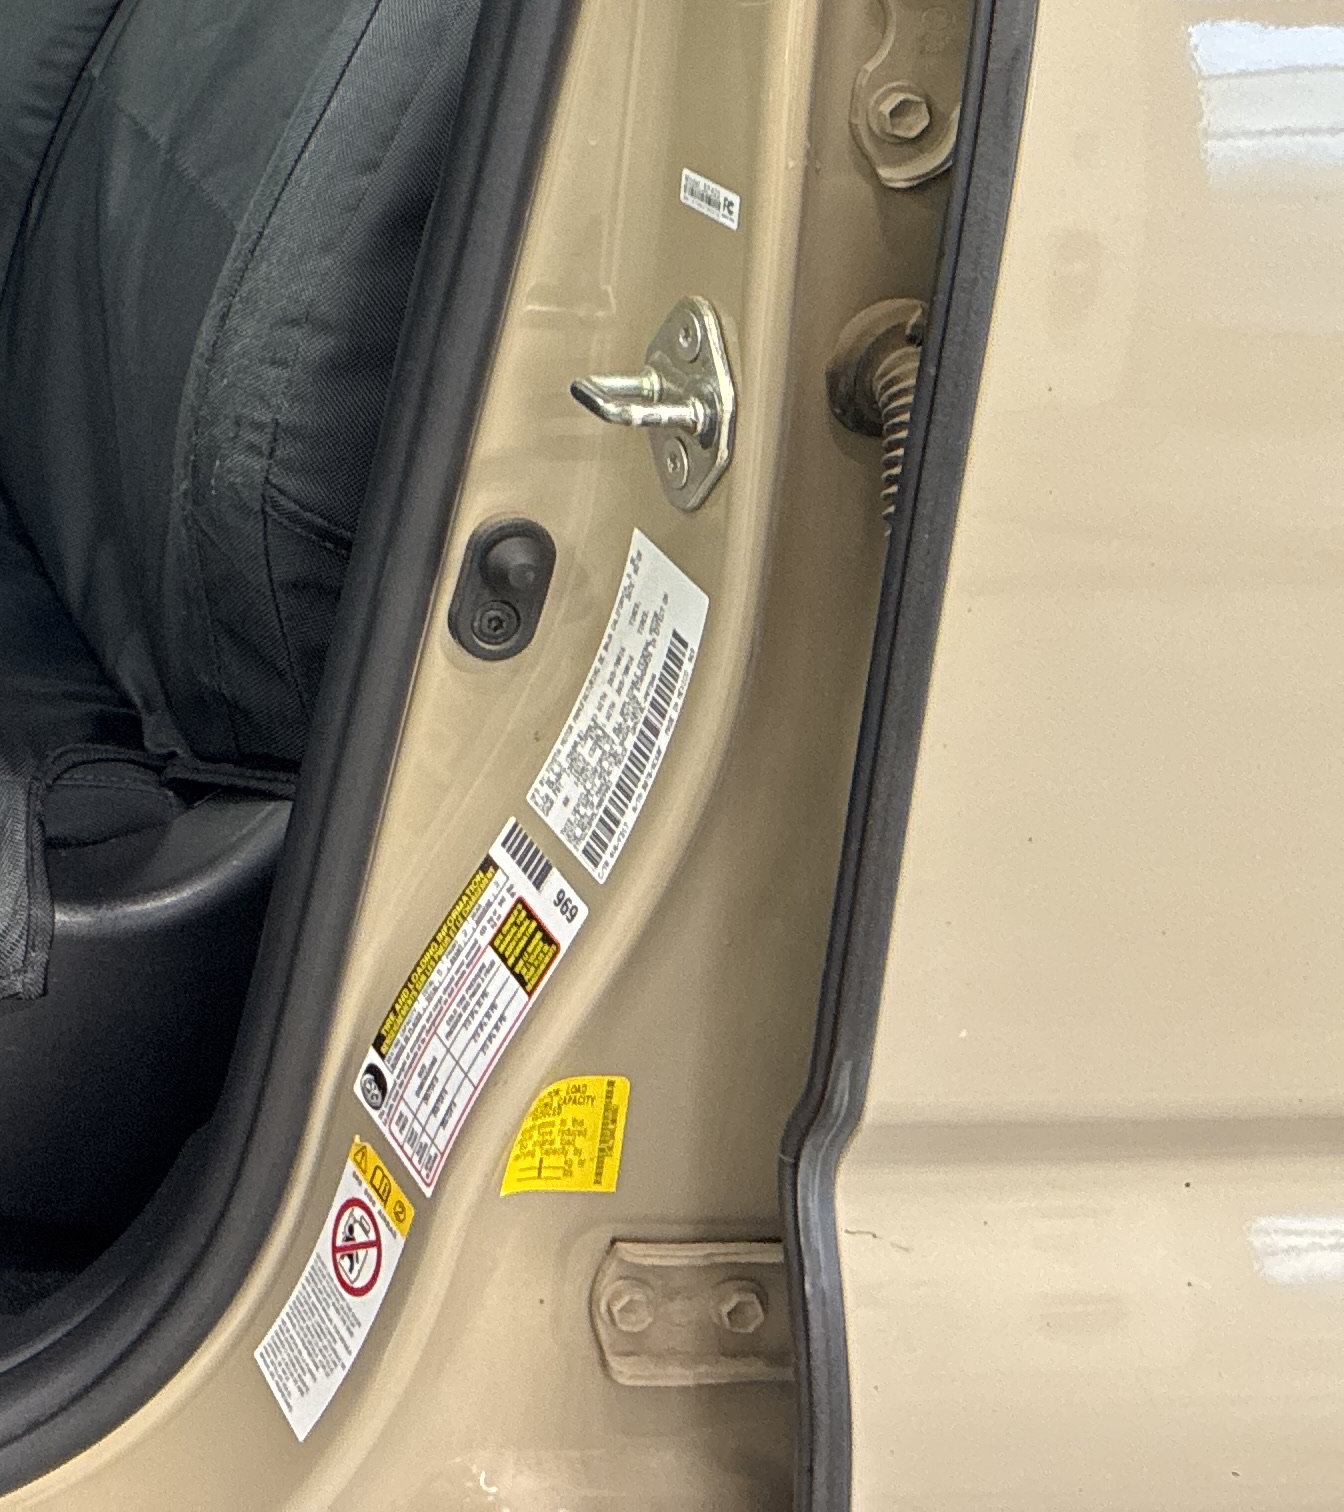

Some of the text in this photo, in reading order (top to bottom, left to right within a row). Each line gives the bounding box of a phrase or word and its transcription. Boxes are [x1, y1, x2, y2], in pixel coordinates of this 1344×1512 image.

[553, 888, 579, 924] 969
[381, 1010, 395, 1037] TIRE
[394, 987, 409, 1013] AND
[407, 939, 438, 990] LOADING
[435, 869, 484, 943] INFORMATION
[566, 1083, 588, 1095] LOAD
